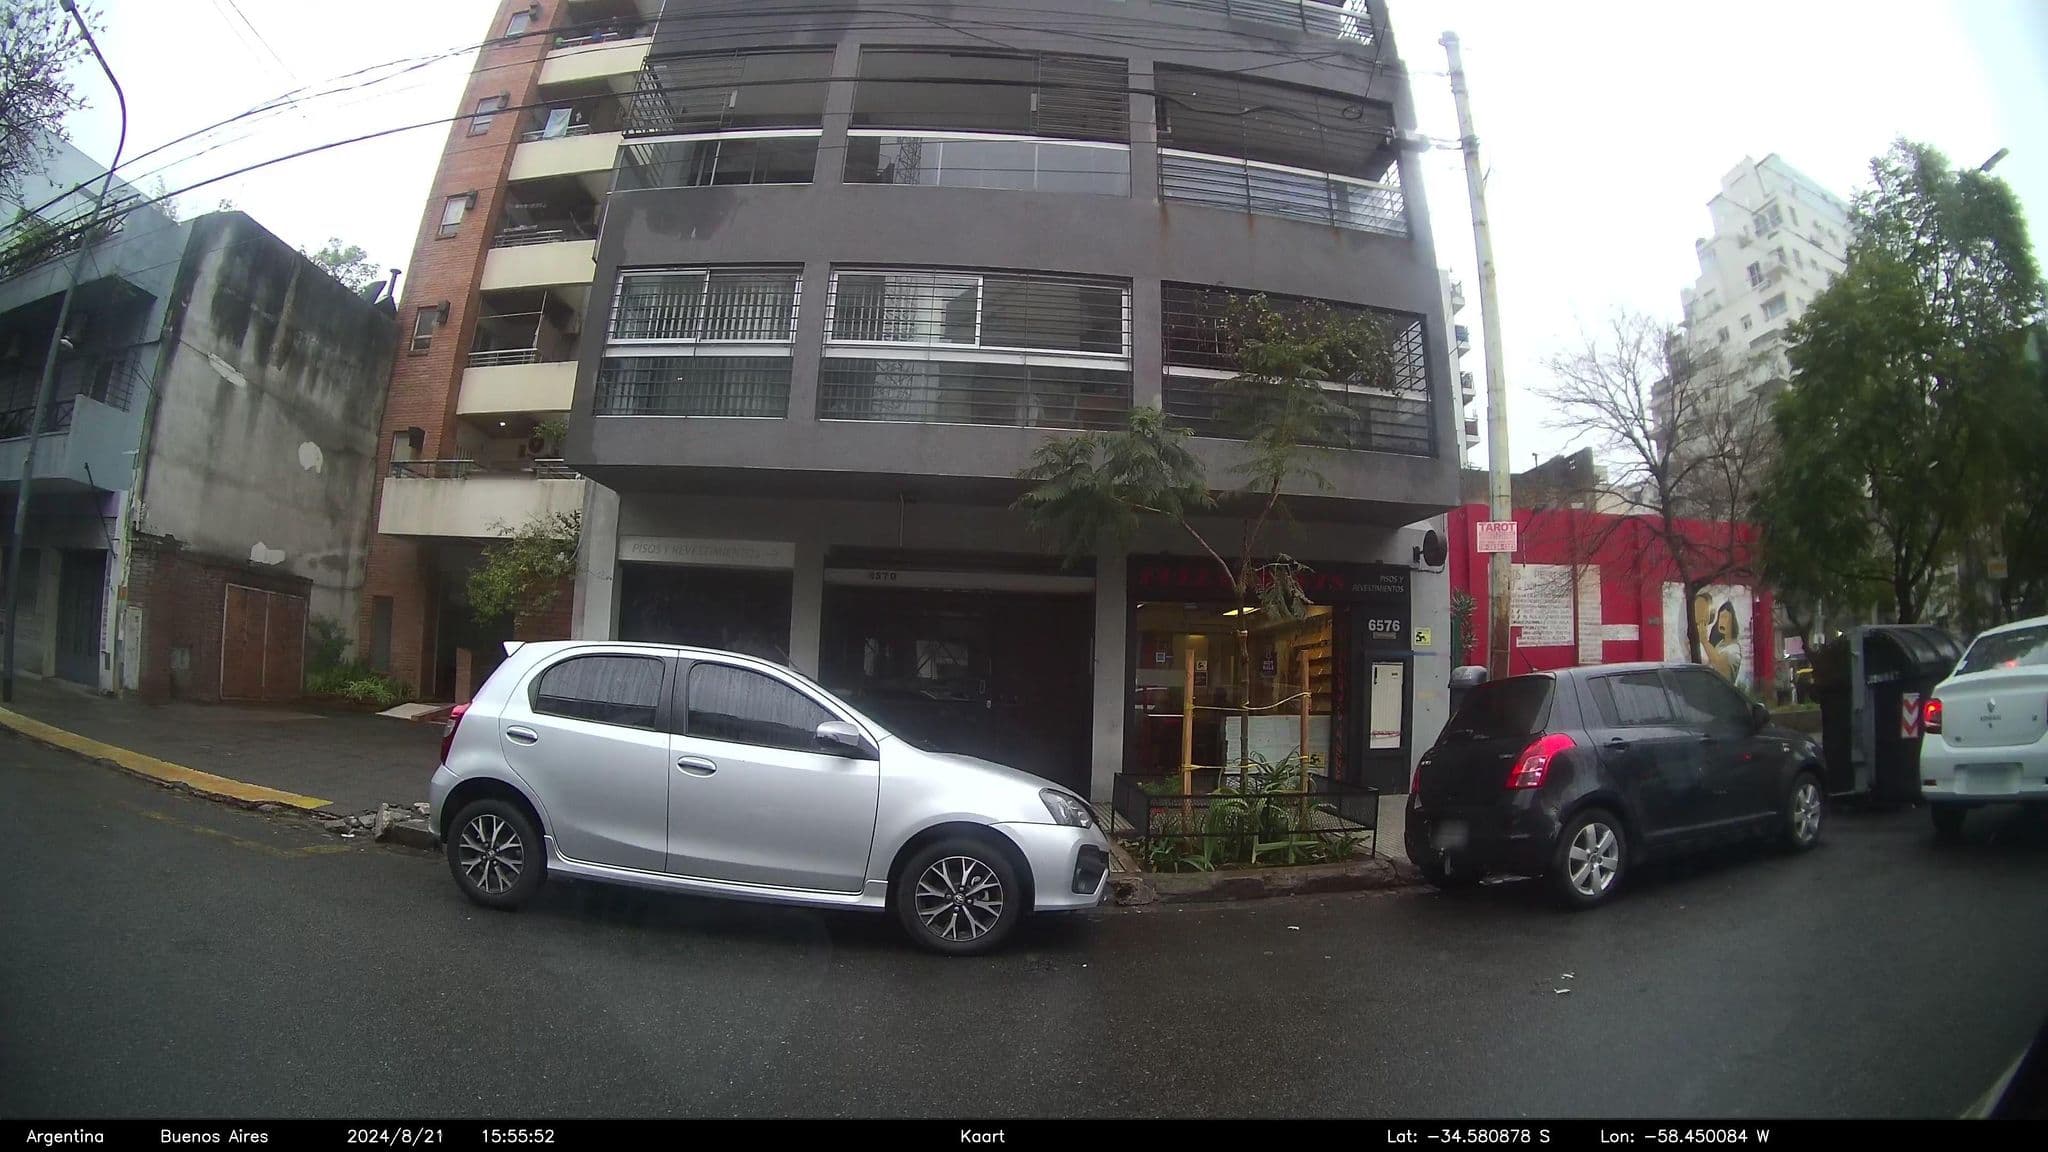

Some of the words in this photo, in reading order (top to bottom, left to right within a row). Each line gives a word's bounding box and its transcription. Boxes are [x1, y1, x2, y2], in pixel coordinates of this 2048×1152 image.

[1478, 522, 1516, 532] TAROT
[632, 542, 660, 554] PISOS
[1379, 575, 1398, 584] PISOS
[1368, 619, 1401, 632] 6576
